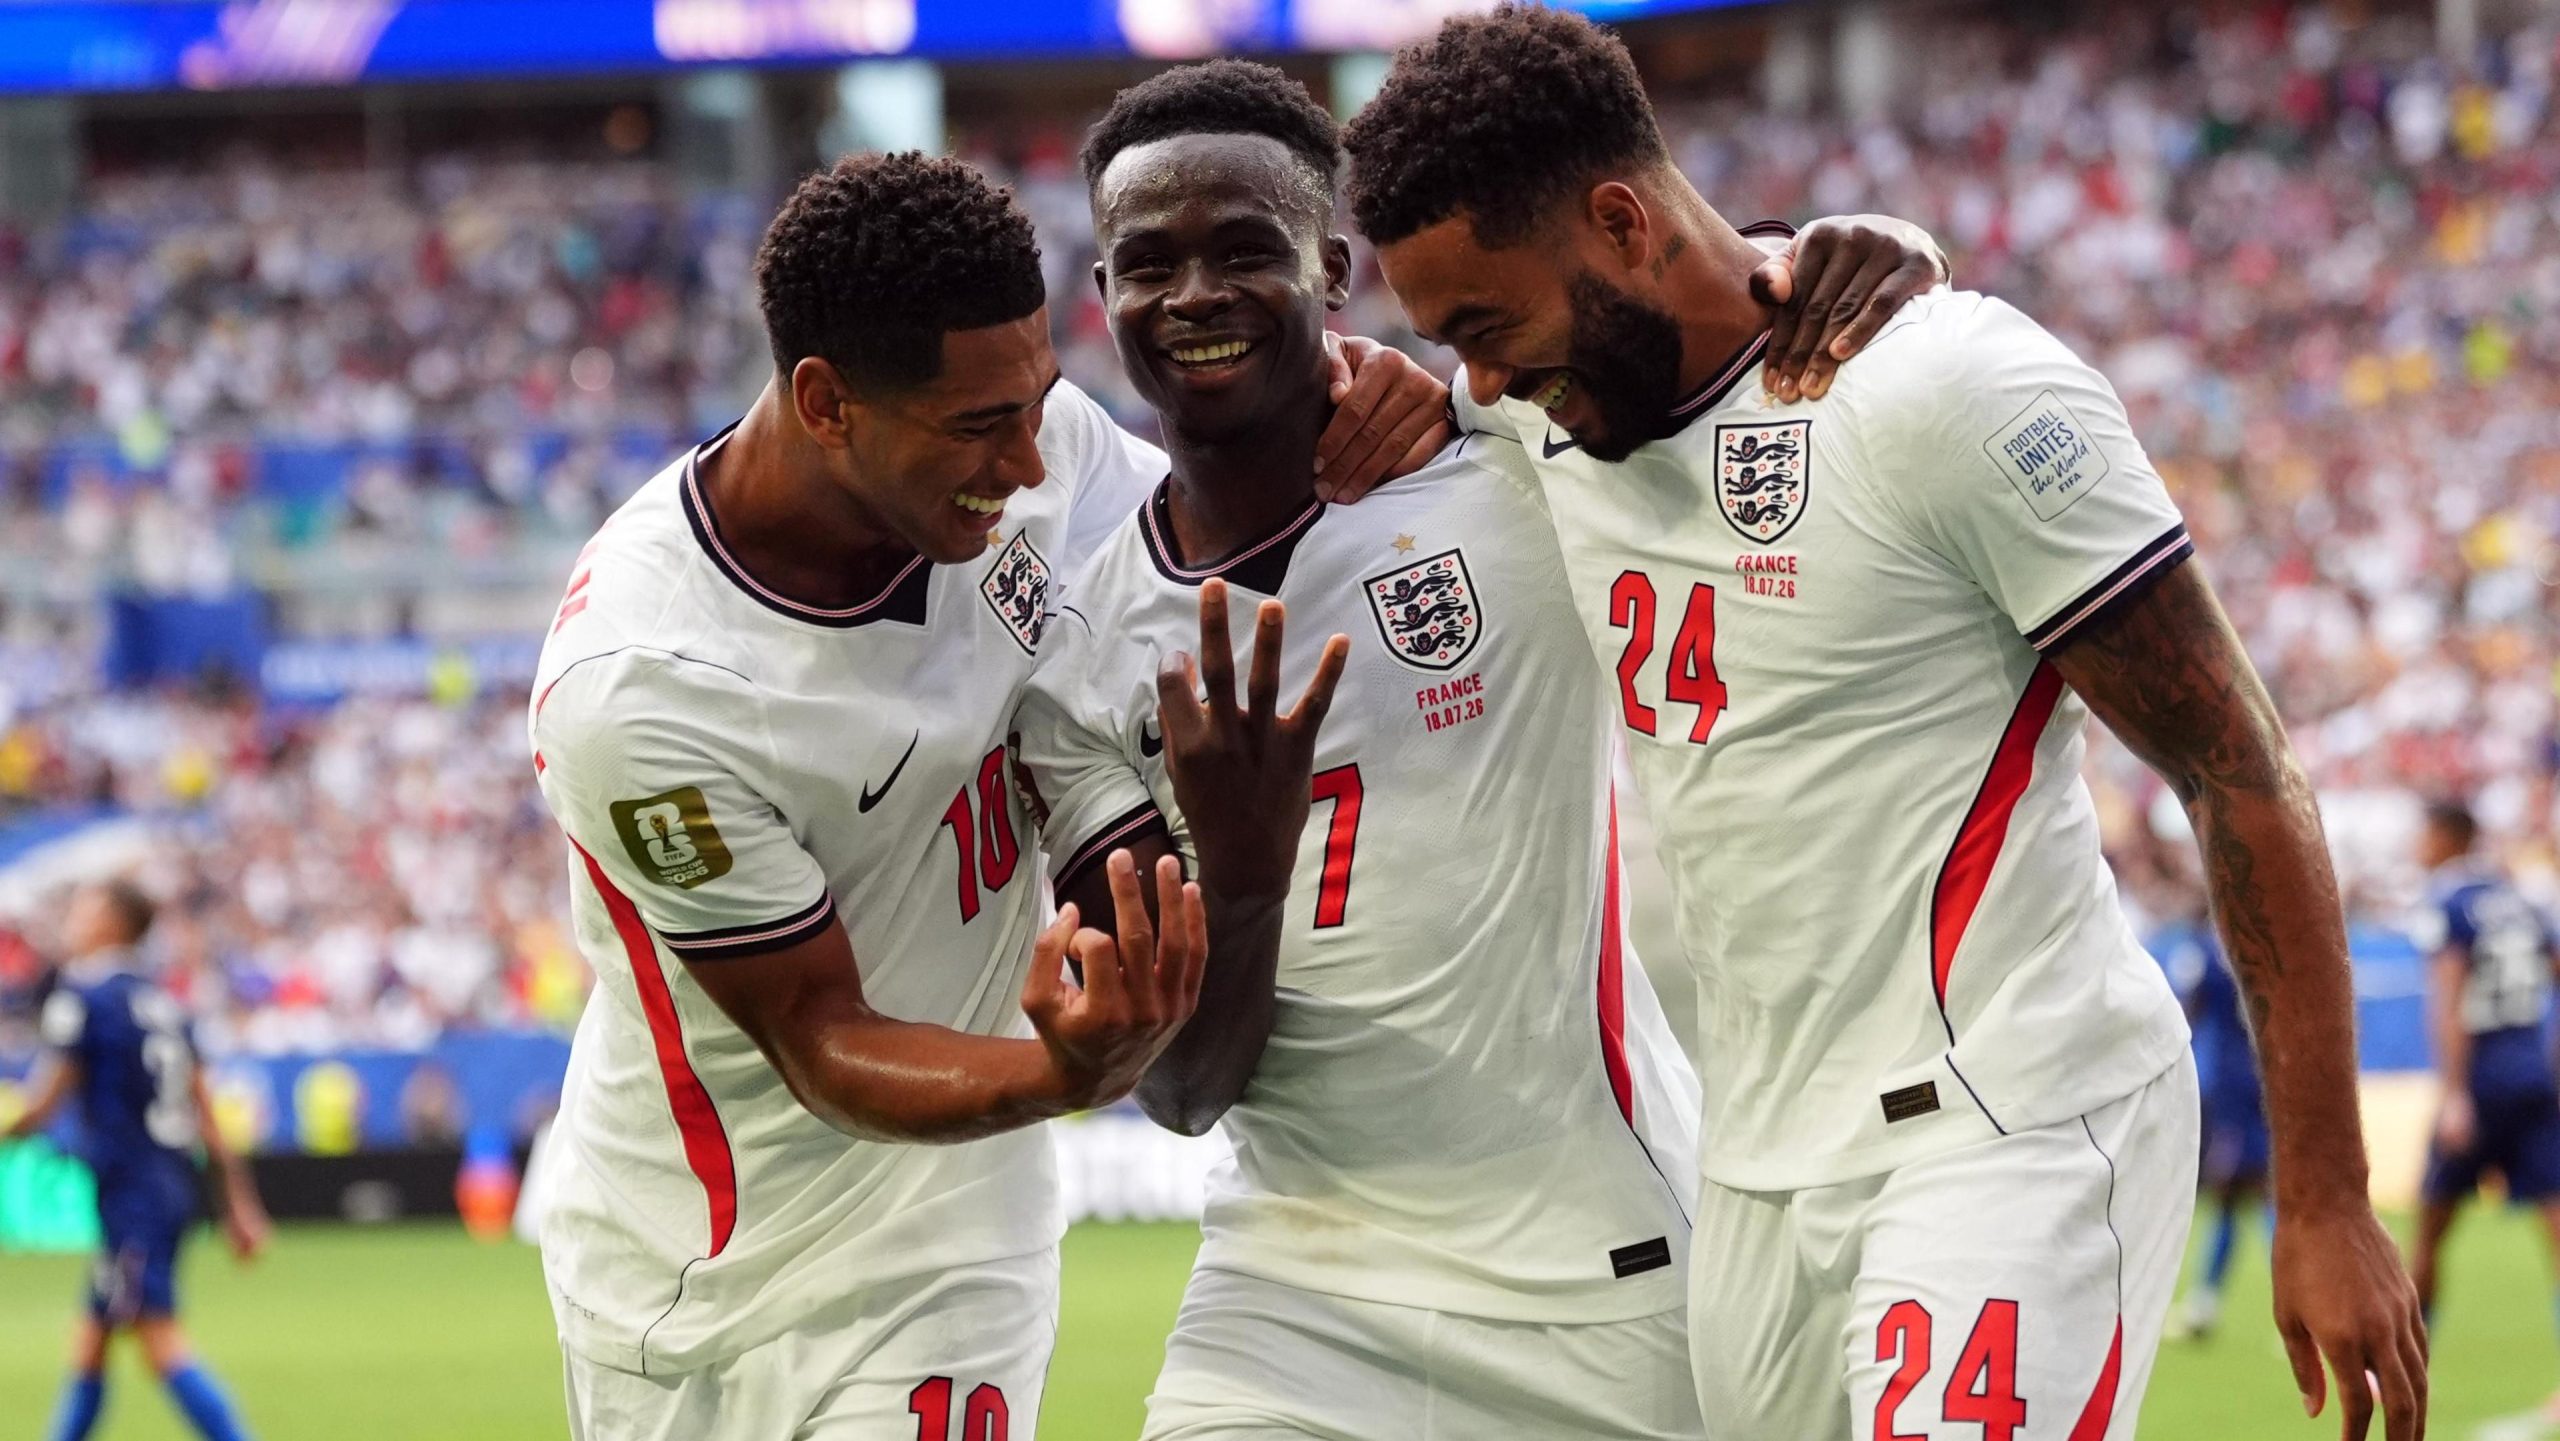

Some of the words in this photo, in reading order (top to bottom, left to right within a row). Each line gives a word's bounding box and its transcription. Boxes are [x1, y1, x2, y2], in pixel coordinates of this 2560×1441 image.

[2003, 409, 2060, 458] FOOTBALL
[2015, 421, 2074, 476] UNITES
[2029, 474, 2054, 495] the
[2051, 437, 2090, 478] World
[2058, 472, 2082, 494] FIFA
[1735, 555, 1798, 575] FRANCE
[1743, 574, 1796, 599] 18.07.26
[1609, 569, 1728, 746] 24
[1416, 672, 1484, 710] FRANCE
[1424, 698, 1485, 733] 18.07.26
[940, 743, 1020, 926] 10
[1311, 762, 1364, 930] 7
[658, 863, 688, 876] WORLD
[687, 858, 704, 870] CUP
[663, 865, 710, 884] 2026
[664, 851, 686, 862] FIFA
[1873, 1297, 2027, 1441] 24
